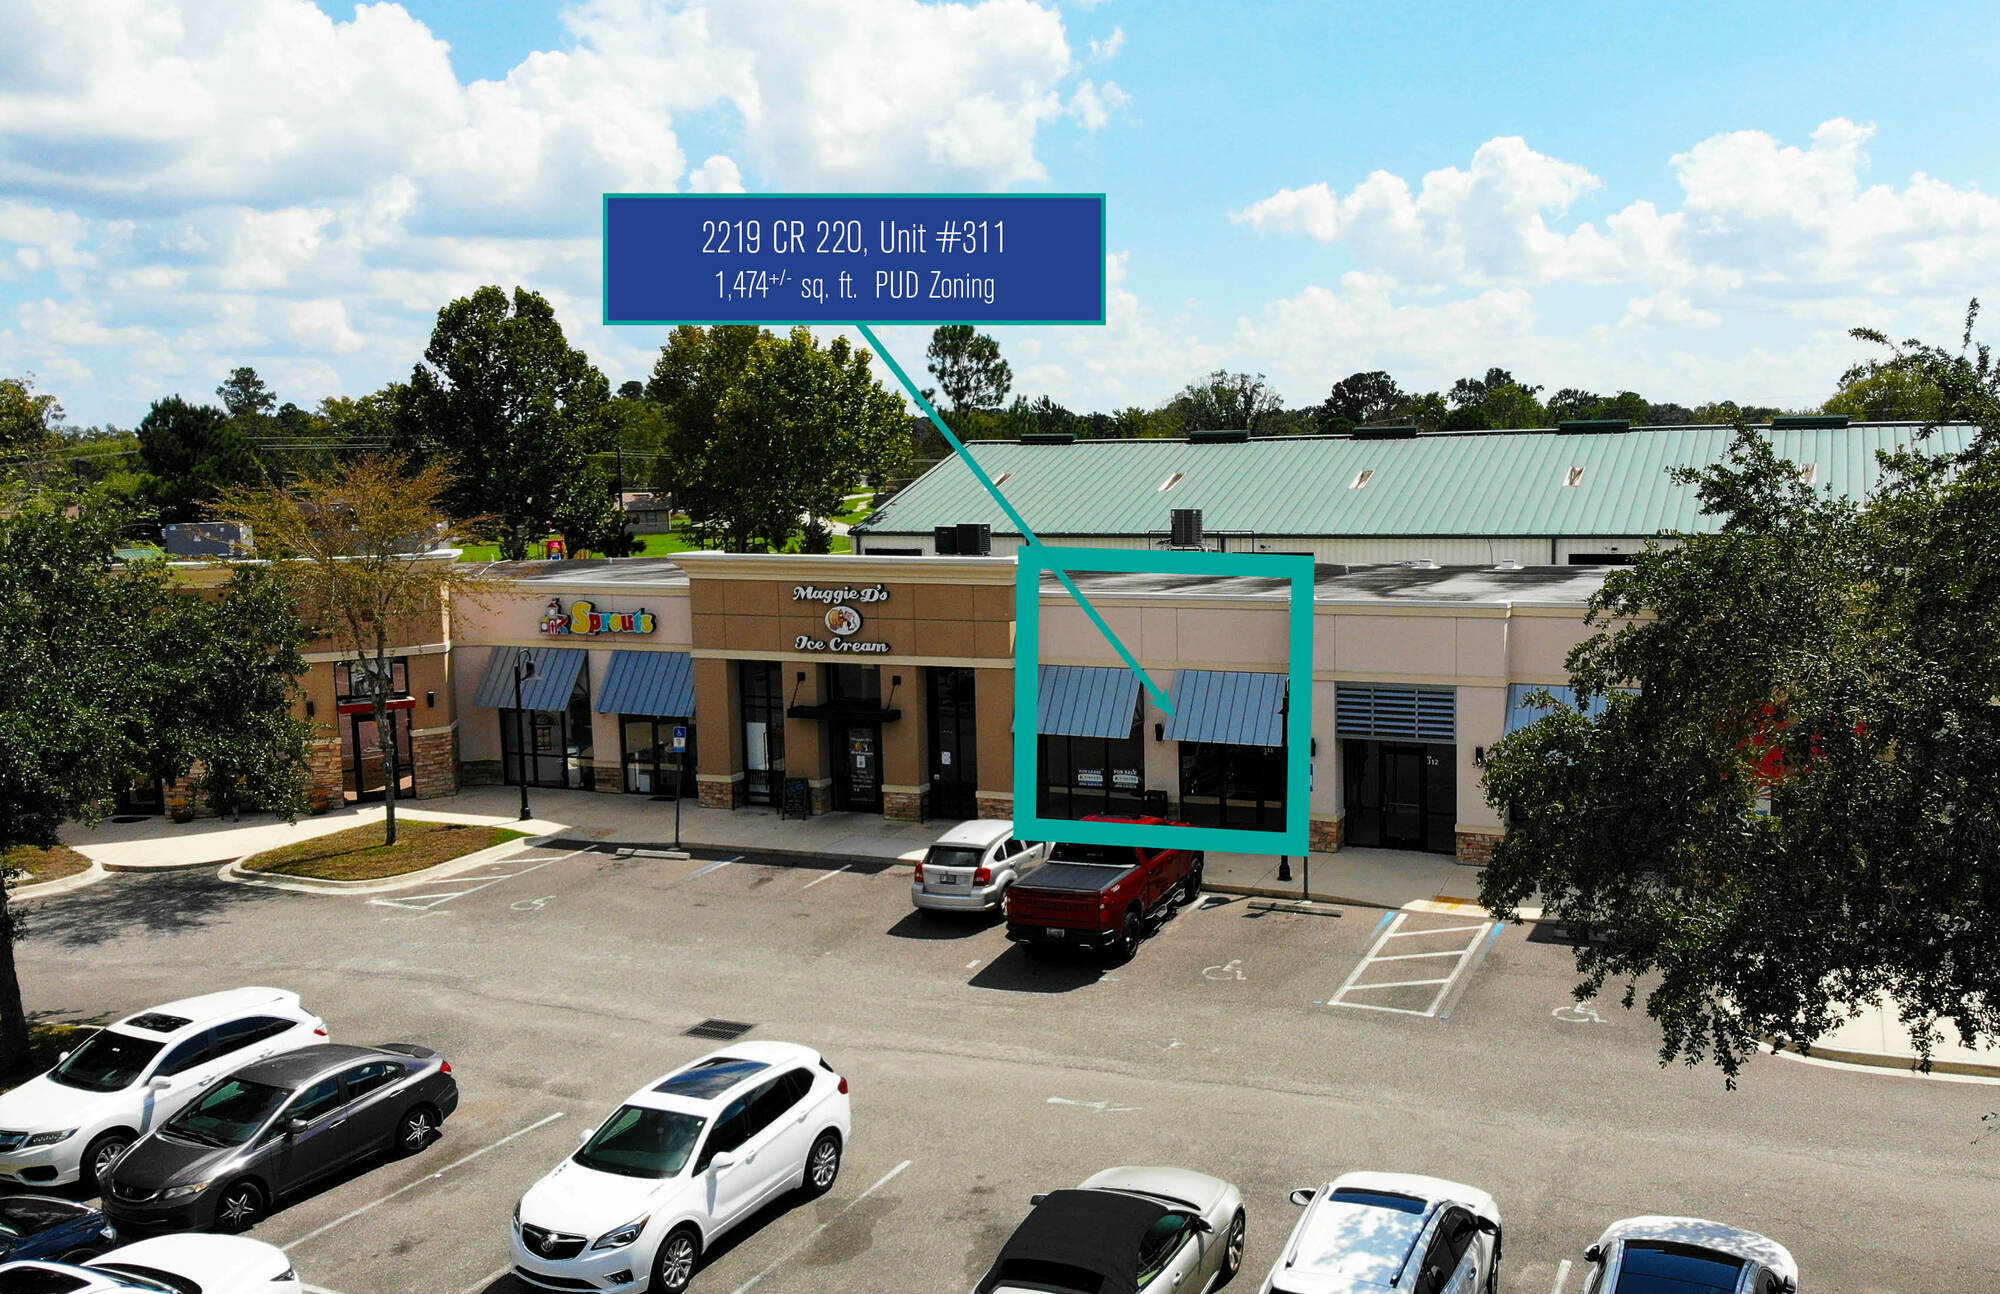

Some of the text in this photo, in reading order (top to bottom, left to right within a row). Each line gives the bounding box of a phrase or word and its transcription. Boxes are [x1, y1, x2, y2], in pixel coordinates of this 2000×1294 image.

[792, 584, 889, 605] Maggie D's
[570, 600, 657, 635] Sprouts
[794, 635, 890, 653] Ice Cream
